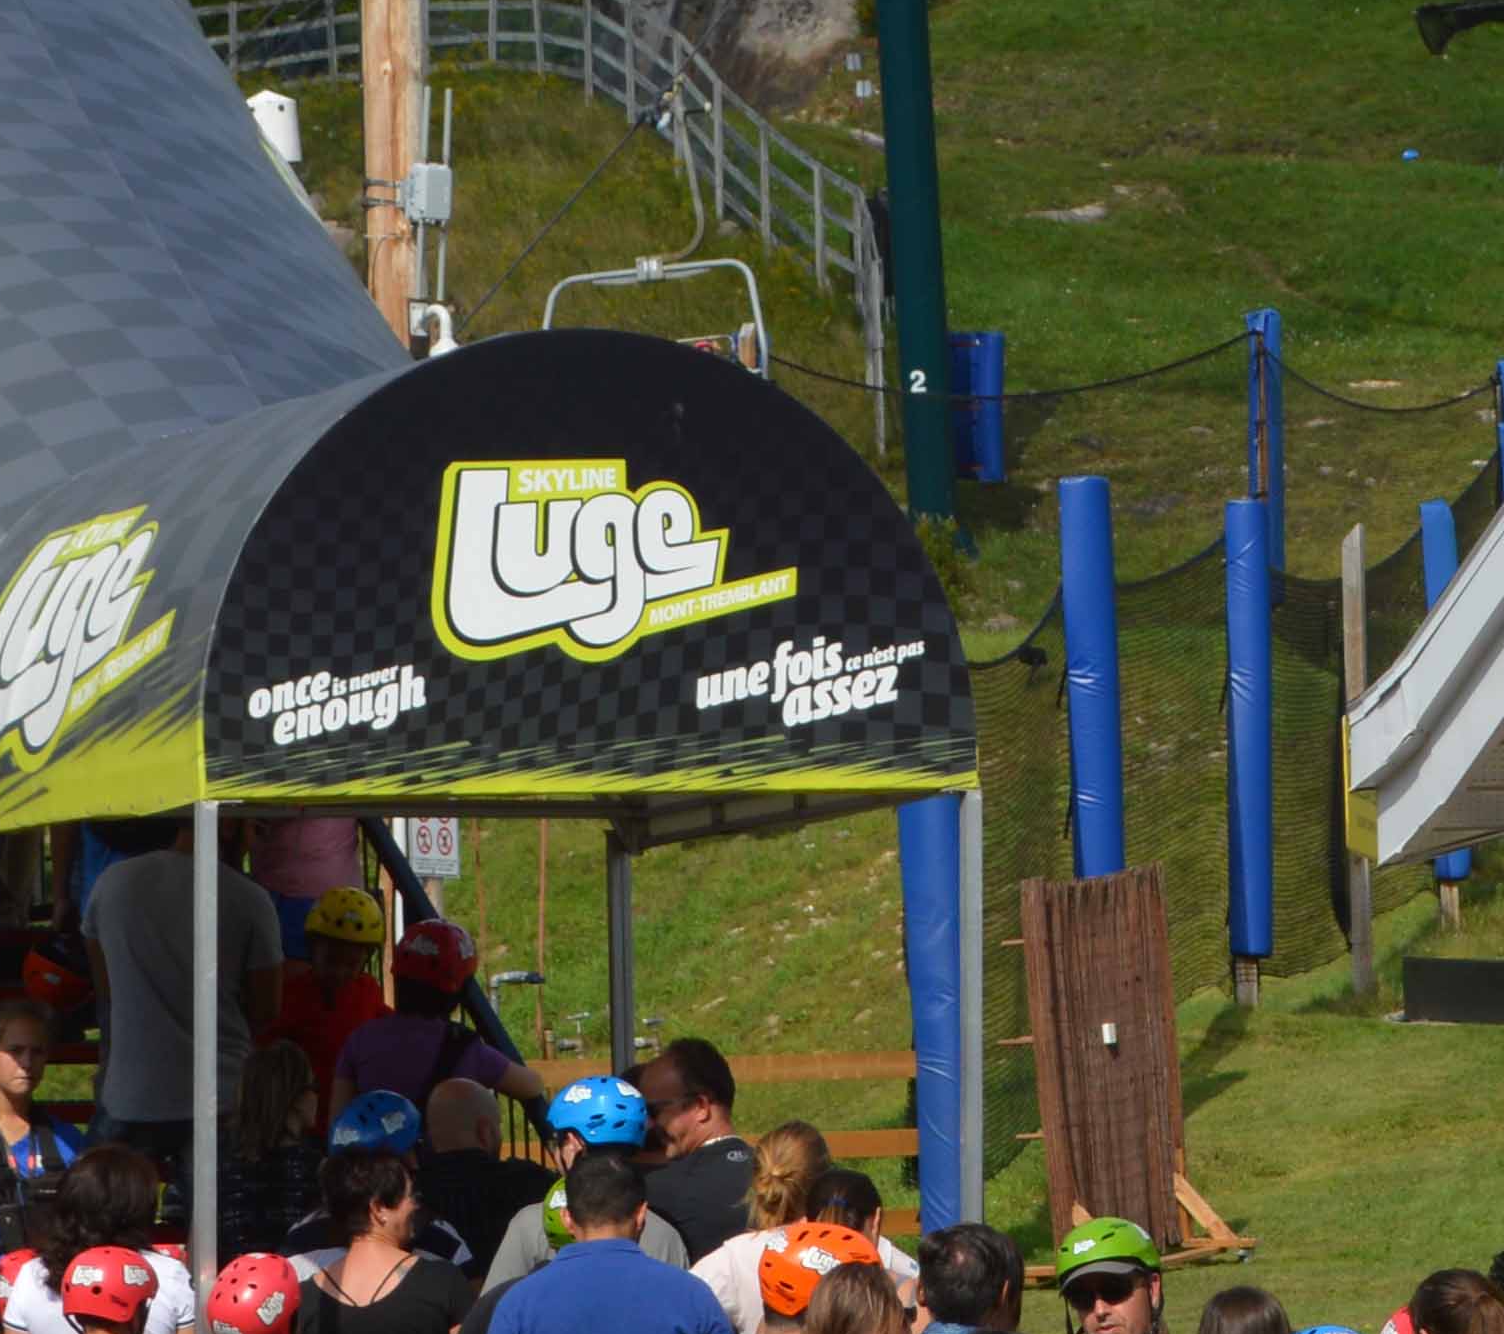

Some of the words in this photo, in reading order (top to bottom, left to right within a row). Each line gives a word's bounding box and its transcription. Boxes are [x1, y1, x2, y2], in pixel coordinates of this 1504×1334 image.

[909, 370, 927, 395] 2
[518, 467, 617, 494] SKYLINE
[449, 469, 720, 645] Luge
[649, 574, 790, 625] MONT-TREMBLANT
[248, 671, 332, 718] once
[332, 677, 347, 695] is
[349, 665, 399, 693] never
[697, 661, 769, 710] une
[769, 636, 844, 703] fois
[846, 655, 862, 672] ce
[863, 647, 897, 669] n'est
[897, 641, 925, 664] pas
[783, 666, 899, 727] assez
[273, 665, 427, 745] enough
